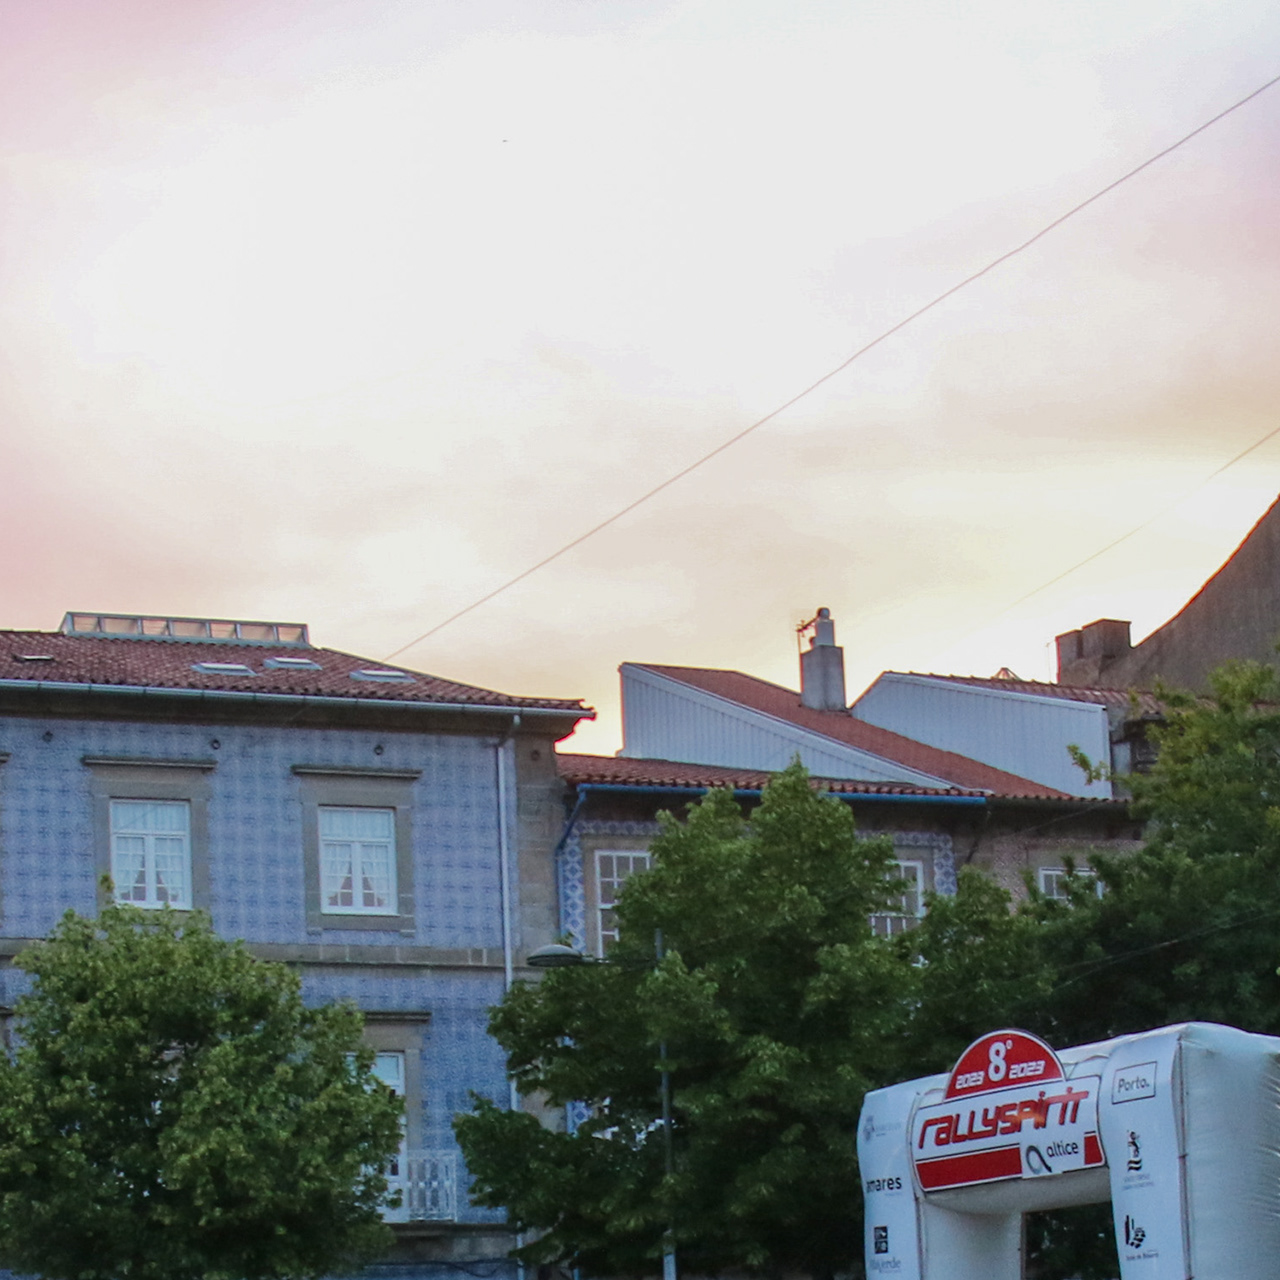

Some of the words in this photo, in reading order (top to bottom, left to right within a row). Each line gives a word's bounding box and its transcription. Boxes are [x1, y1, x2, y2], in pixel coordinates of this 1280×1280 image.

[1009, 1060, 1045, 1078] 2023
[955, 1071, 985, 1089] 2023
[1046, 1140, 1079, 1157] altice
